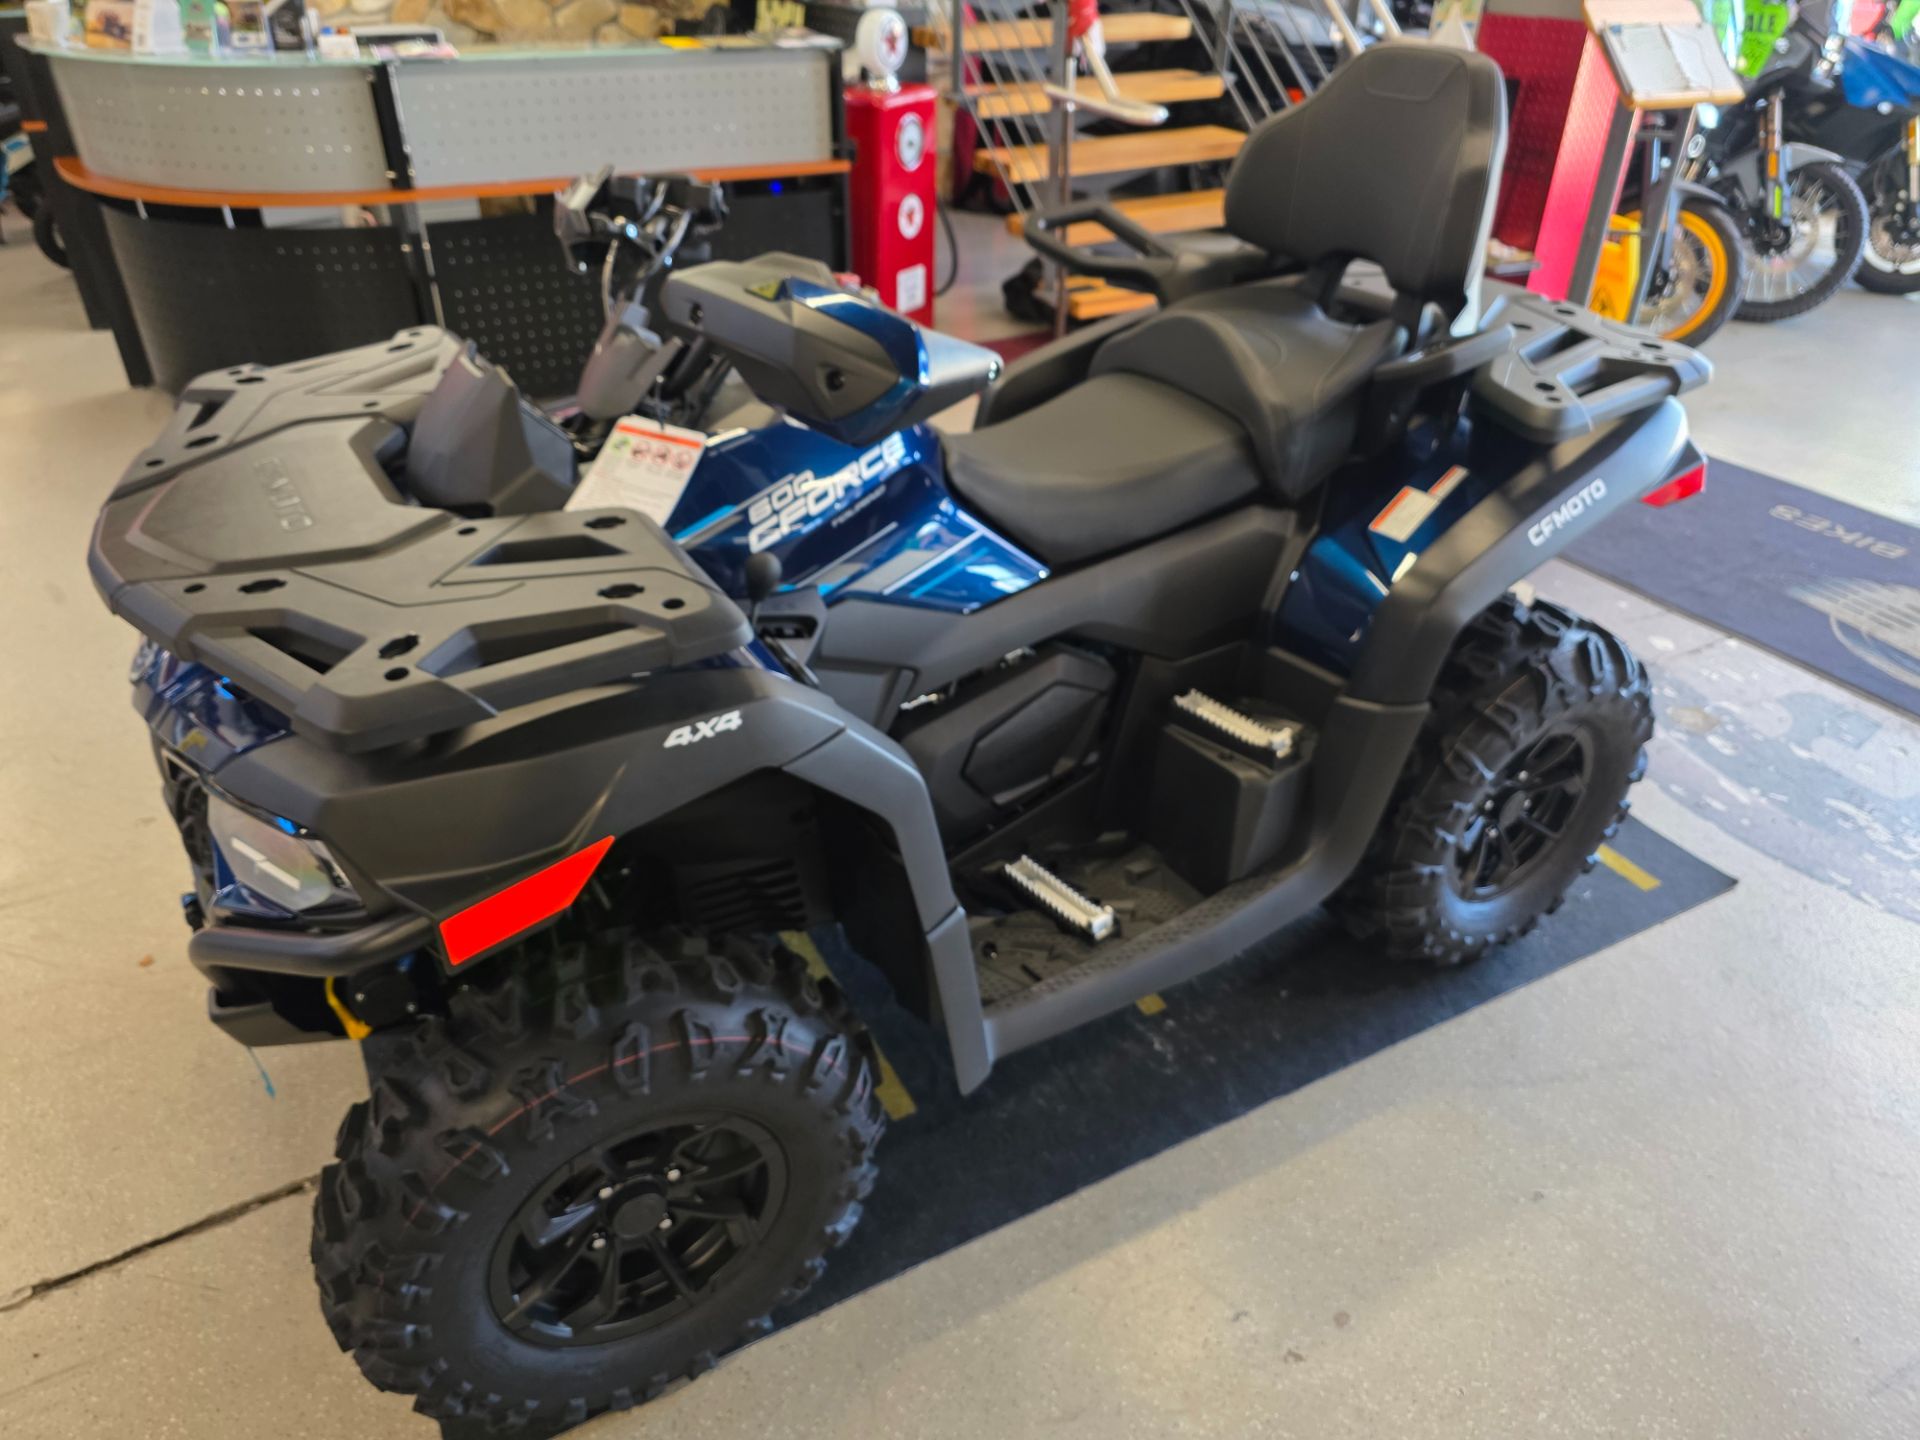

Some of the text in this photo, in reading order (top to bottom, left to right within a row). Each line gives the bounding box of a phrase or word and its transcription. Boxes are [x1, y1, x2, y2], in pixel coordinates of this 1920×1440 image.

[748, 430, 906, 555] CFORCE
[1527, 477, 1608, 547] CFMOTO
[1768, 503, 1909, 560] BIKES
